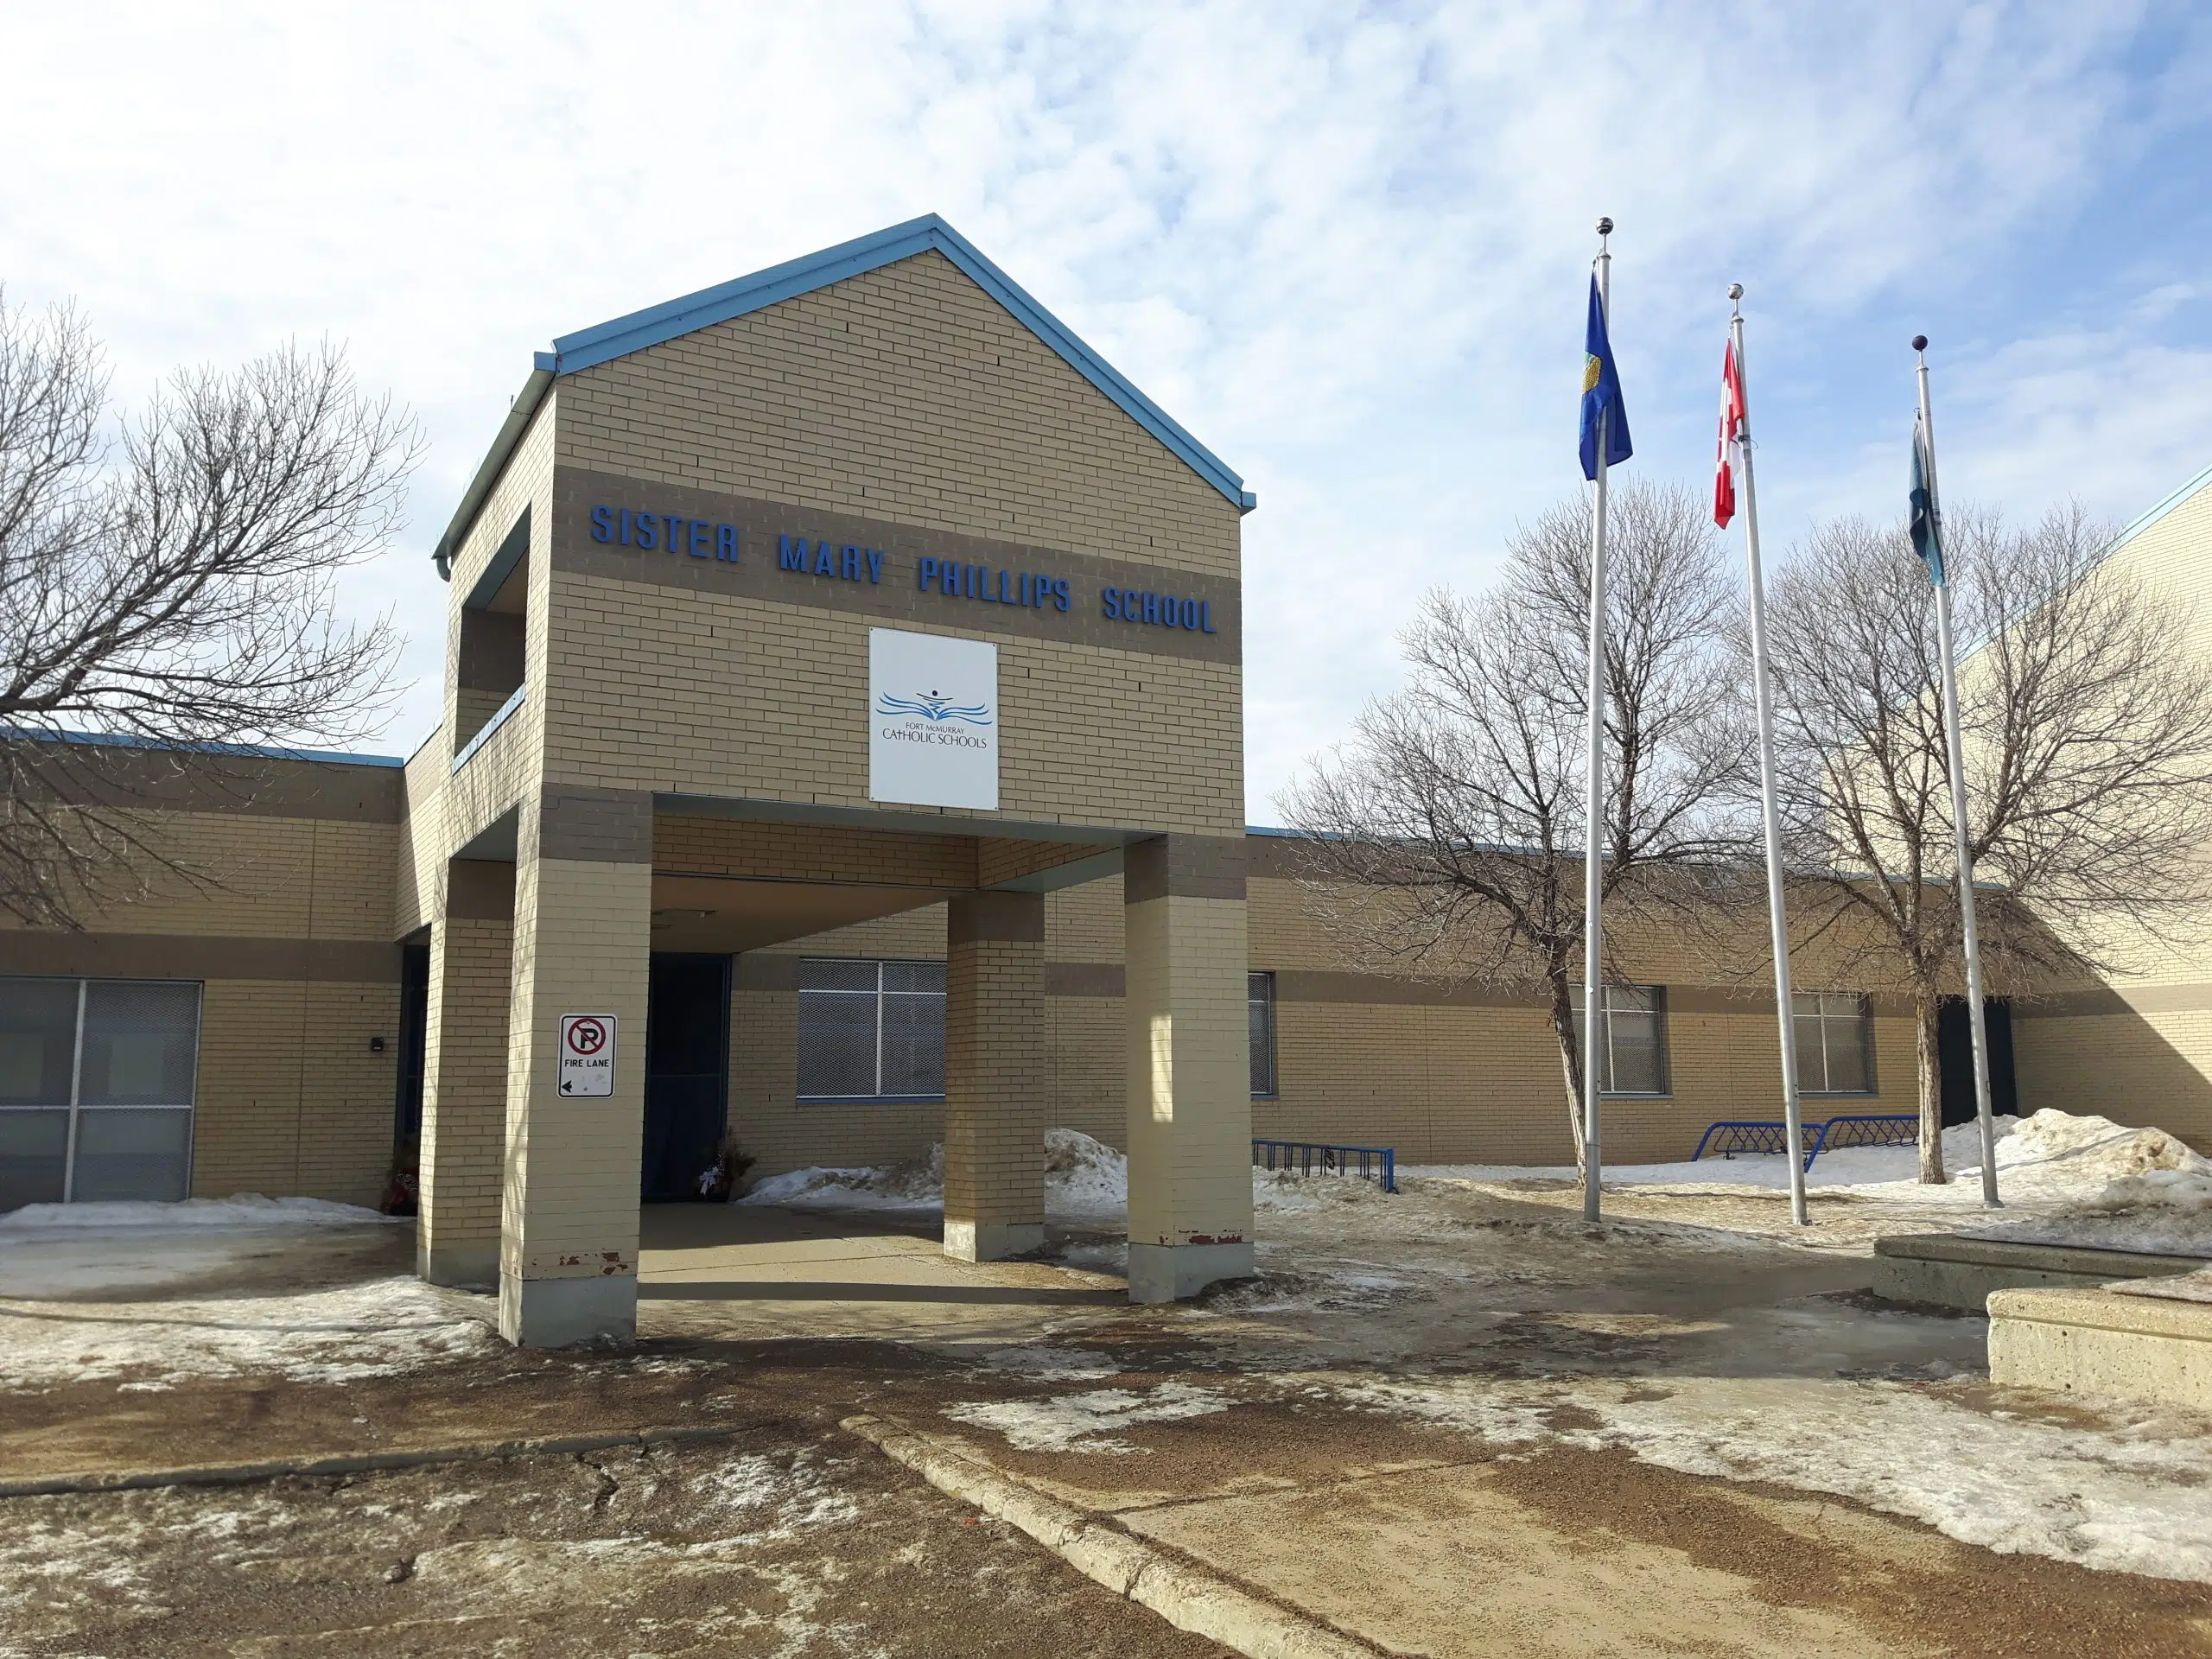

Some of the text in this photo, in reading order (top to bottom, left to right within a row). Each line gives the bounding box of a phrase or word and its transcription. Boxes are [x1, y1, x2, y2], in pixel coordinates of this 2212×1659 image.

[590, 504, 1218, 634] SISTER MARY PHILLIPS SCHOOL
[906, 721, 965, 734] FORT McMURRAY
[882, 728, 987, 748] CATHOLIC SCHOOLS
